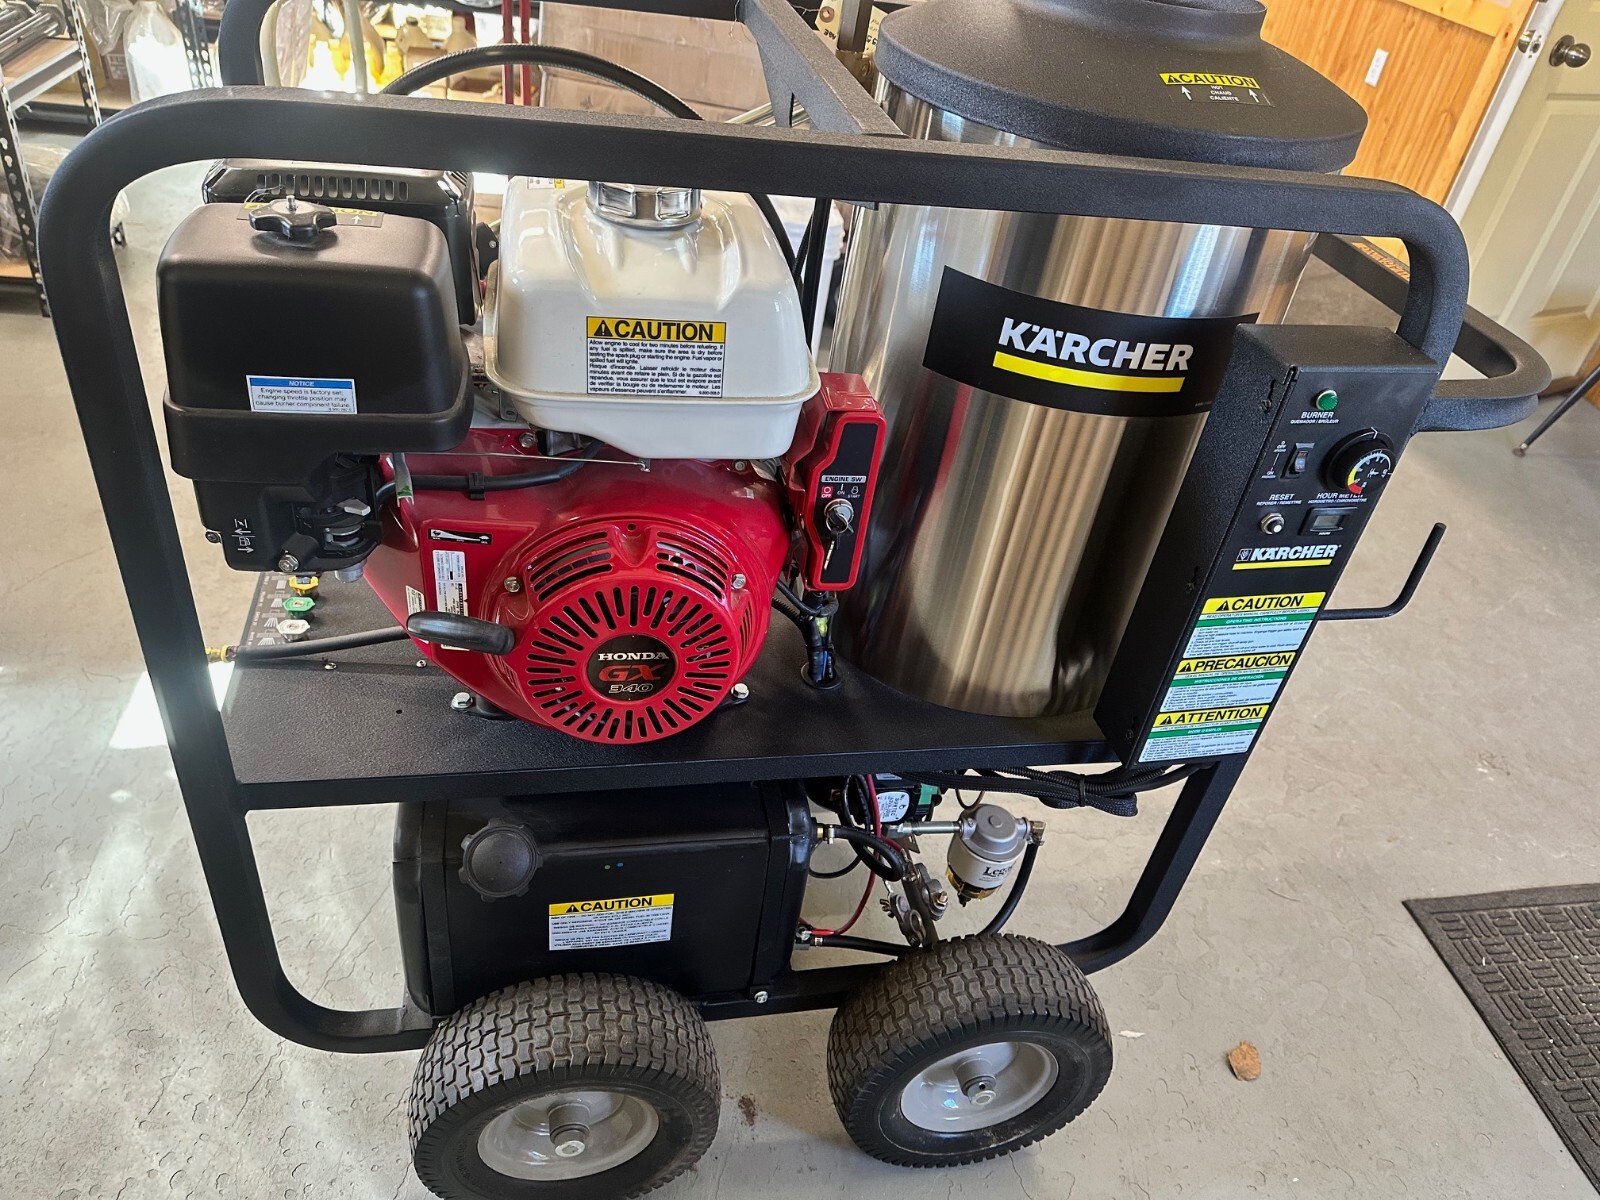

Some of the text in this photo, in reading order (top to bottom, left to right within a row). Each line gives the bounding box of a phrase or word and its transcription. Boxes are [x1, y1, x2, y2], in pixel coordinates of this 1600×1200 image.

[1179, 74, 1257, 88] CAUTION
[614, 320, 714, 341] CAUTION
[998, 317, 1194, 370] KÄRCHER
[1252, 545, 1340, 561] KÄRCHER
[1232, 595, 1304, 610] CAUTION
[598, 652, 670, 661] HONDA
[1193, 653, 1292, 671] PRECAUCIÓN
[598, 664, 666, 682] GX
[608, 683, 654, 694] 340
[1175, 707, 1263, 724] ATTENTION
[580, 897, 652, 912] CAUTION
